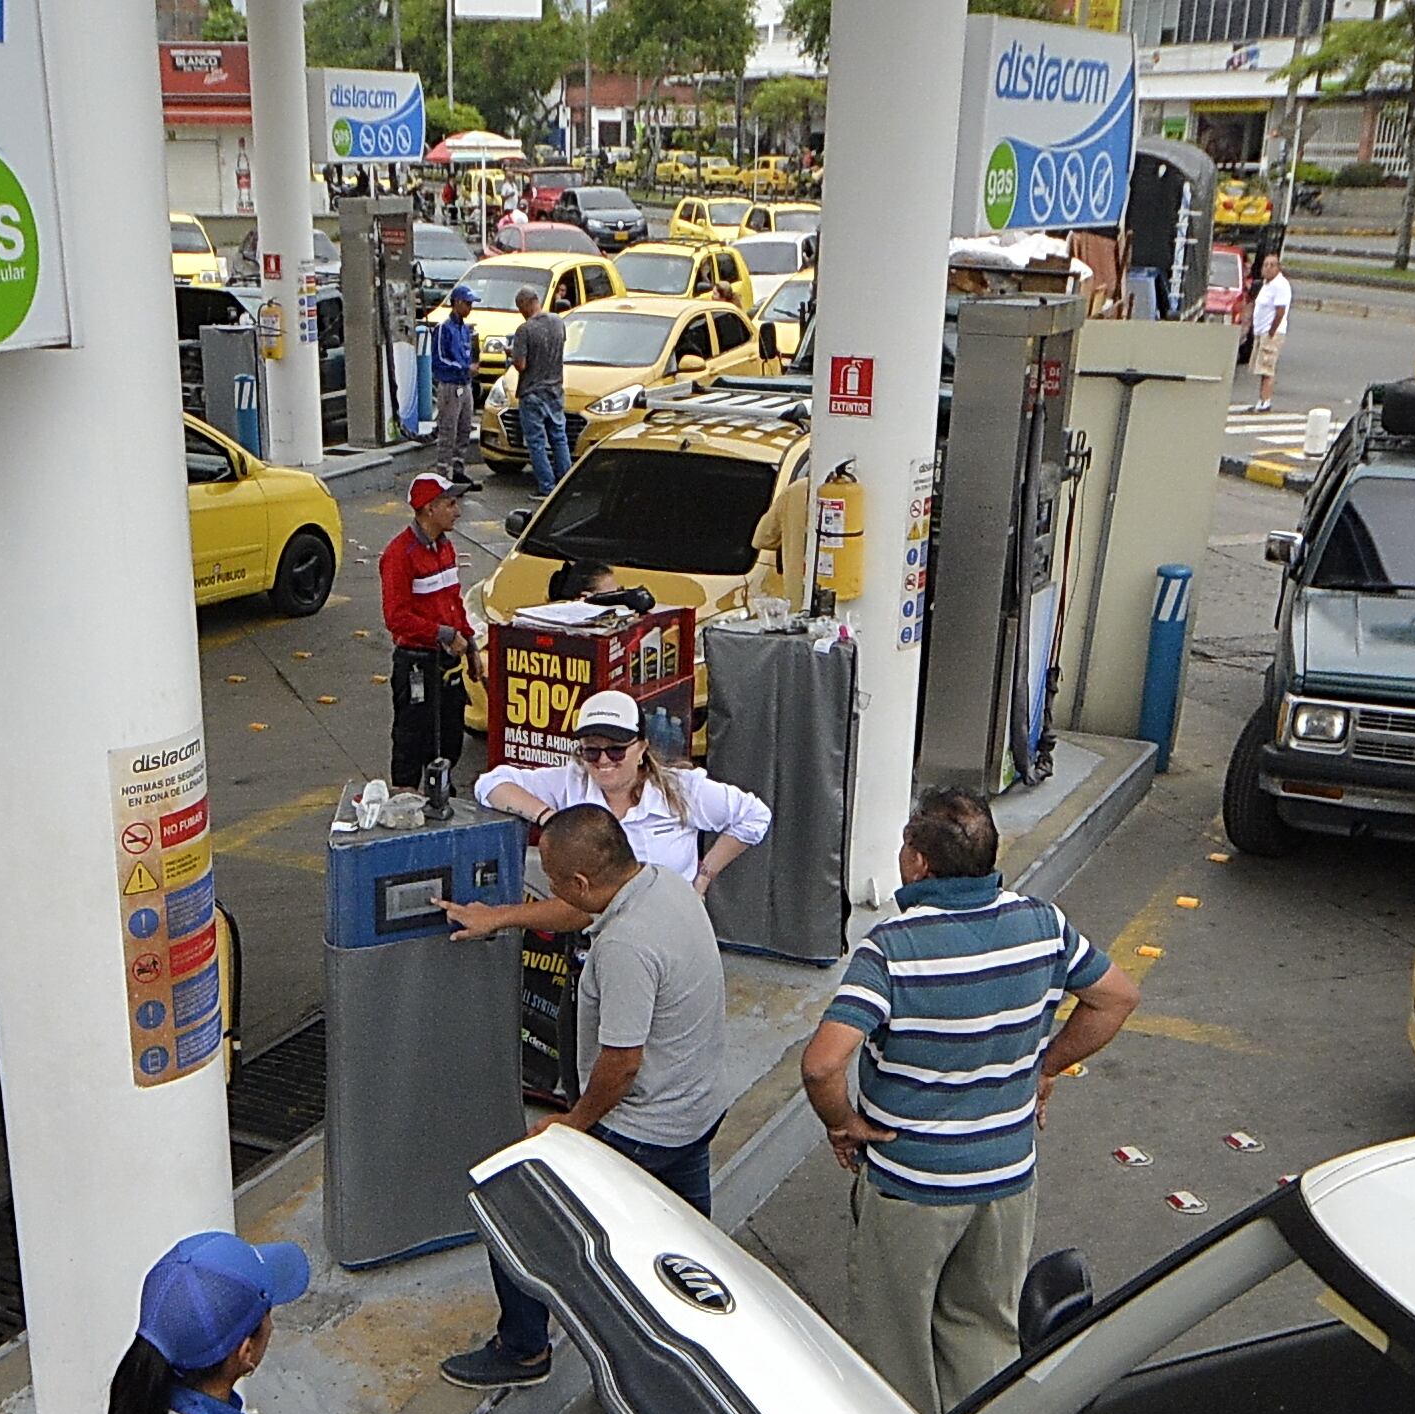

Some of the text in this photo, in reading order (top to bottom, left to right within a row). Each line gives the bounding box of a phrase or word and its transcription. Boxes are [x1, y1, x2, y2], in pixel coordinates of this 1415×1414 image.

[175, 55, 218, 66] BLANCO
[995, 40, 1110, 104] distracom
[330, 84, 397, 109] distracom
[987, 169, 1014, 205] gas
[831, 401, 869, 414] EXTINTOR
[506, 648, 562, 679] HASTA
[566, 657, 591, 684] UN
[506, 676, 581, 733] 50%
[504, 725, 529, 745] MÁS
[530, 731, 544, 747] DE
[132, 738, 201, 774] distracom
[504, 743, 516, 759] DE
[121, 779, 164, 796] NORMAS
[165, 777, 176, 788] DE
[128, 797, 142, 808] EN
[144, 791, 169, 805] ZONA
[170, 789, 181, 798] DE
[163, 823, 177, 837] NO
[664, 1257, 728, 1307] KIA
